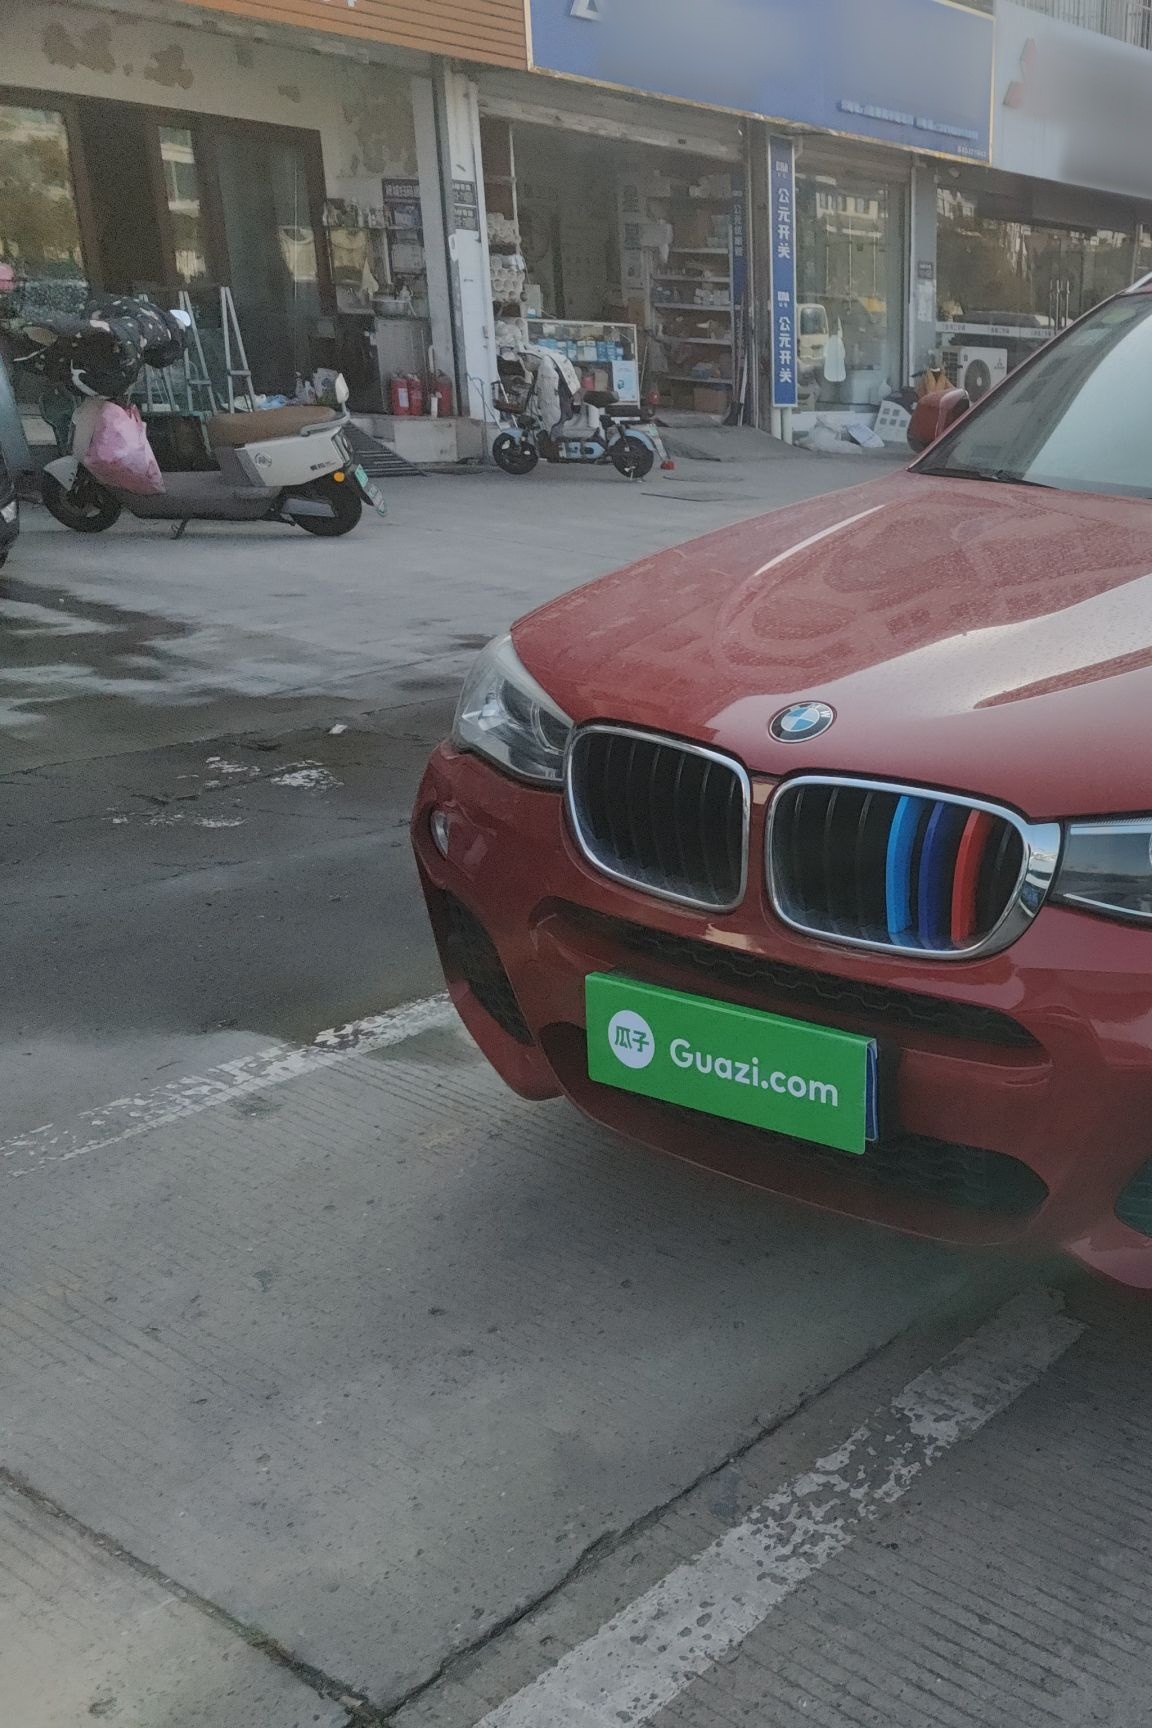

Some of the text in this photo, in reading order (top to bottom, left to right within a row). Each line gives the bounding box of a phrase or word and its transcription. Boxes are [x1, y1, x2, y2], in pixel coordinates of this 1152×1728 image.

[777, 187, 791, 259] 公元开关
[778, 316, 792, 383] 公元开关
[614, 1025, 839, 1107] 瓜子 Guazi.com
